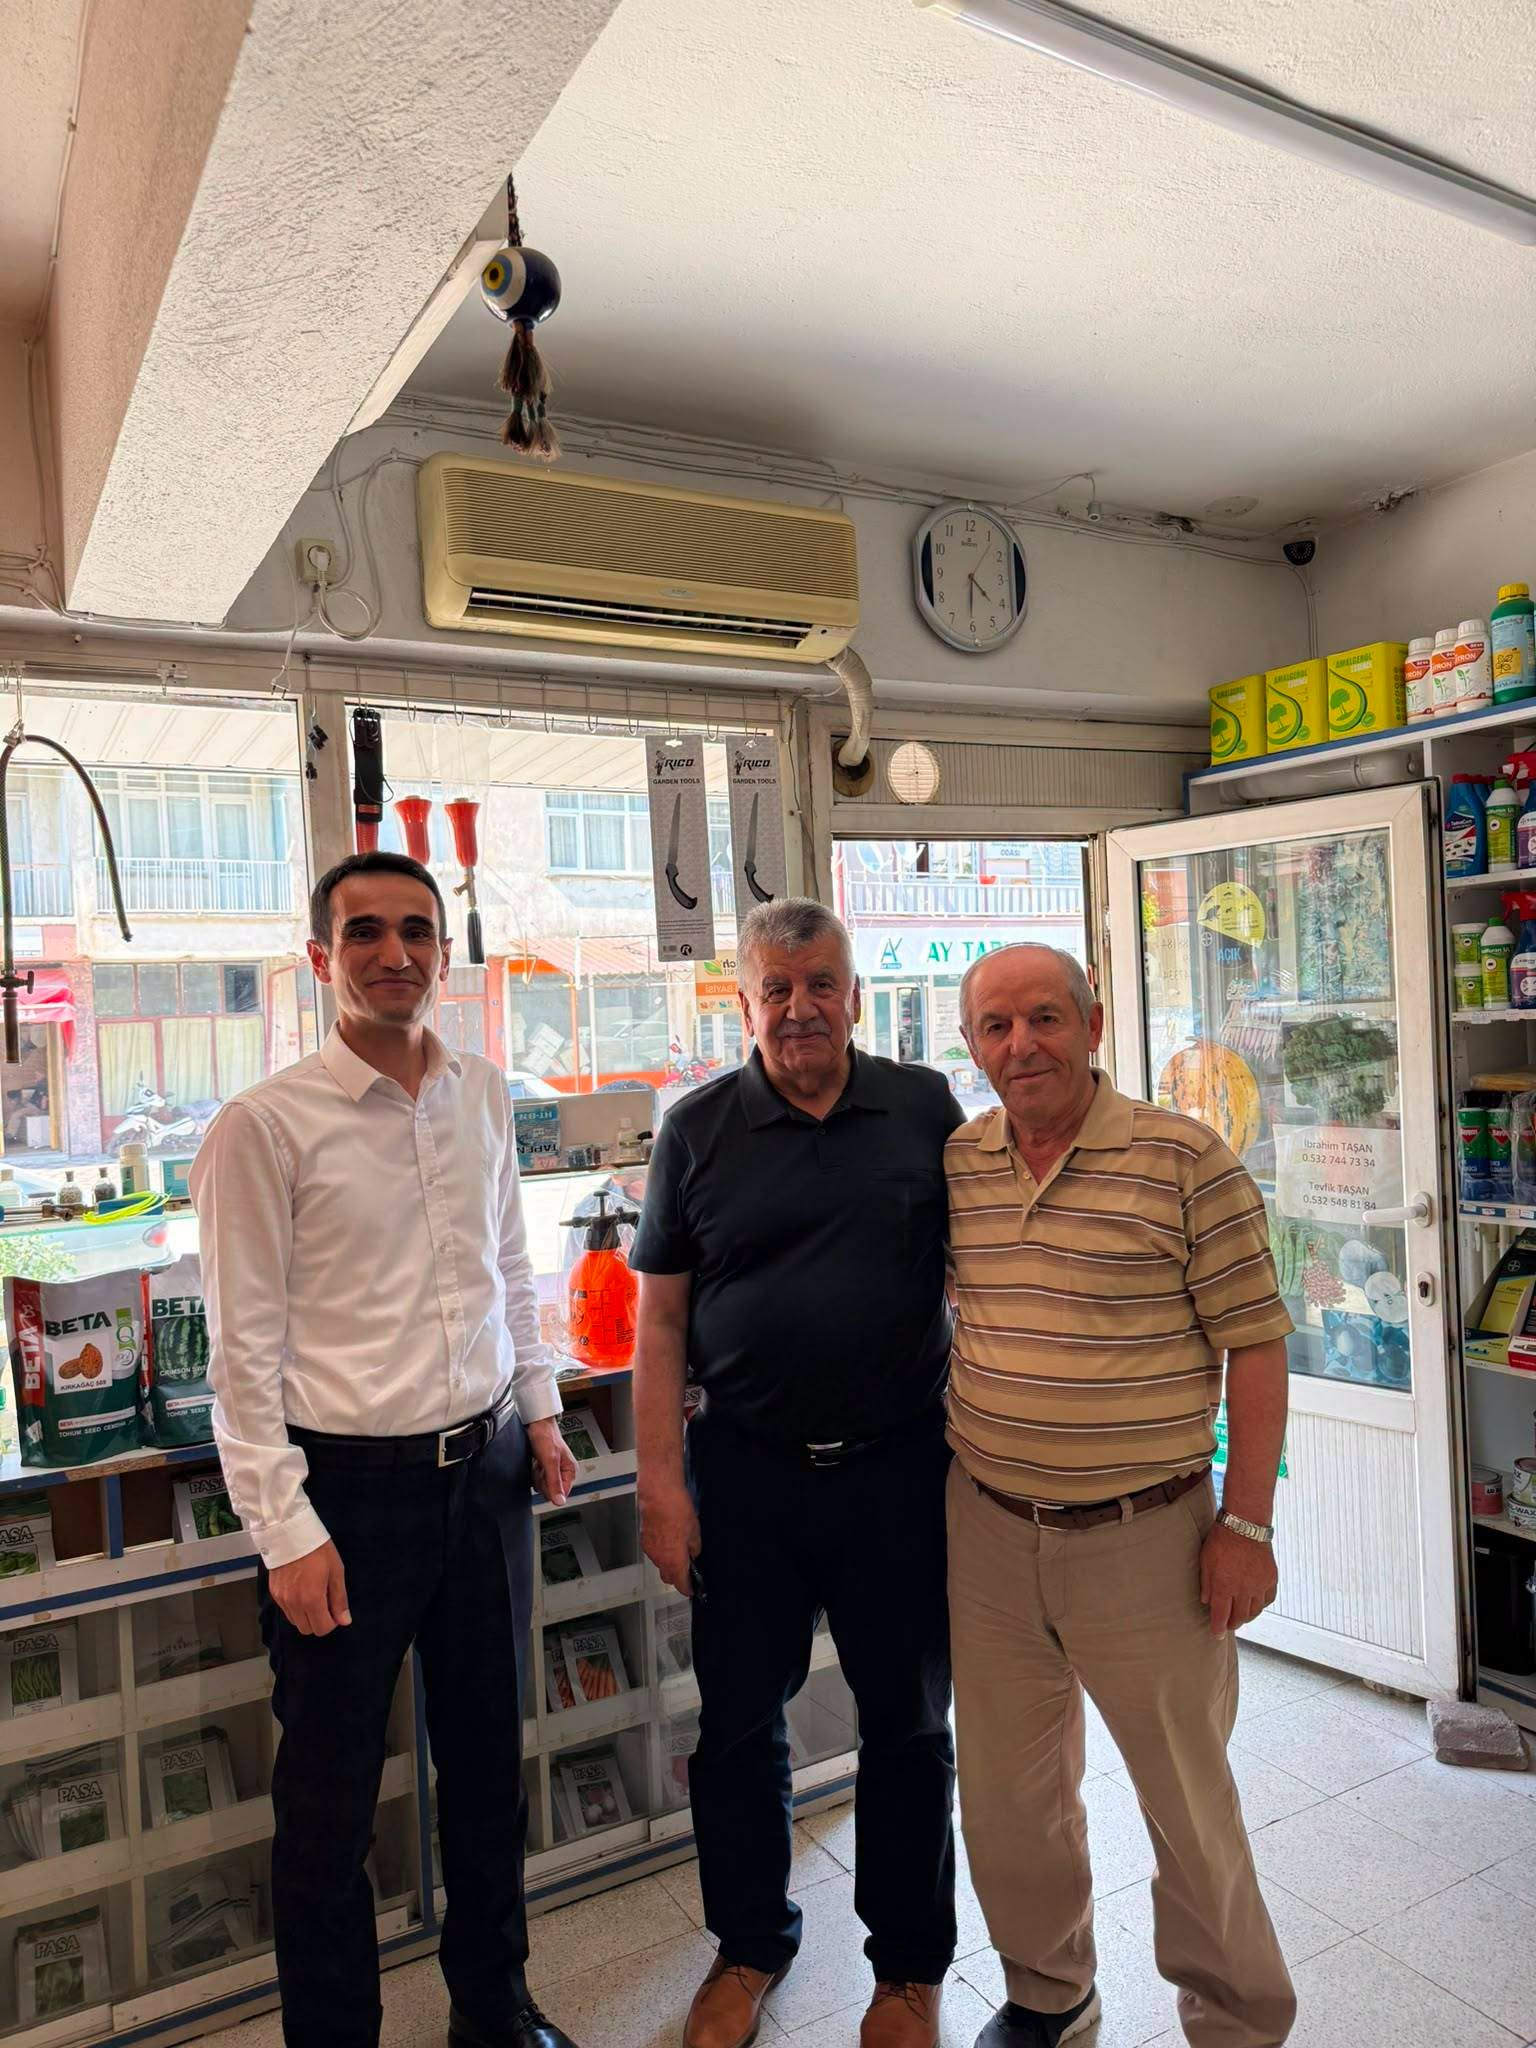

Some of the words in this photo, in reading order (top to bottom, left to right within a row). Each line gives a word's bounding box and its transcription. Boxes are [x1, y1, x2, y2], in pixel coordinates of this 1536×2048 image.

[945, 524, 954, 537] 11
[965, 520, 976, 532] 12
[986, 530, 991, 542] 1
[935, 543, 945, 555] 10
[996, 550, 1003, 563] 2
[936, 566, 944, 579] 9
[997, 574, 1004, 586] 3
[938, 591, 945, 604] 8
[999, 599, 1005, 609] 4
[948, 611, 956, 624] 7
[989, 616, 996, 628] 5
[969, 620, 977, 633] 6
[664, 758, 695, 771] RICO
[743, 759, 771, 771] RICO
[927, 942, 953, 962] AY
[1341, 1142, 1373, 1155] TAŞAN
[1302, 1153, 1329, 1164] 0.532
[1329, 1156, 1346, 1165] 744
[1350, 1157, 1361, 1167] 73
[1363, 1158, 1375, 1167] 34
[1309, 1181, 1335, 1192] Tevfik
[1337, 1184, 1370, 1197] TAŞAN
[1303, 1195, 1328, 1206] 0.532
[1350, 1199, 1361, 1209] 81
[1363, 1200, 1376, 1210] 84
[46, 1311, 112, 1336] BETA
[18, 1325, 41, 1389] BETA
[159, 1367, 191, 1377] CRIMSON
[0, 1526, 34, 1545] ASA
[13, 1634, 59, 1656] PASA
[574, 1632, 609, 1651] PASA
[160, 1750, 204, 1771] PASA
[58, 1781, 103, 1804] PASA
[34, 1935, 80, 1959] PASA
